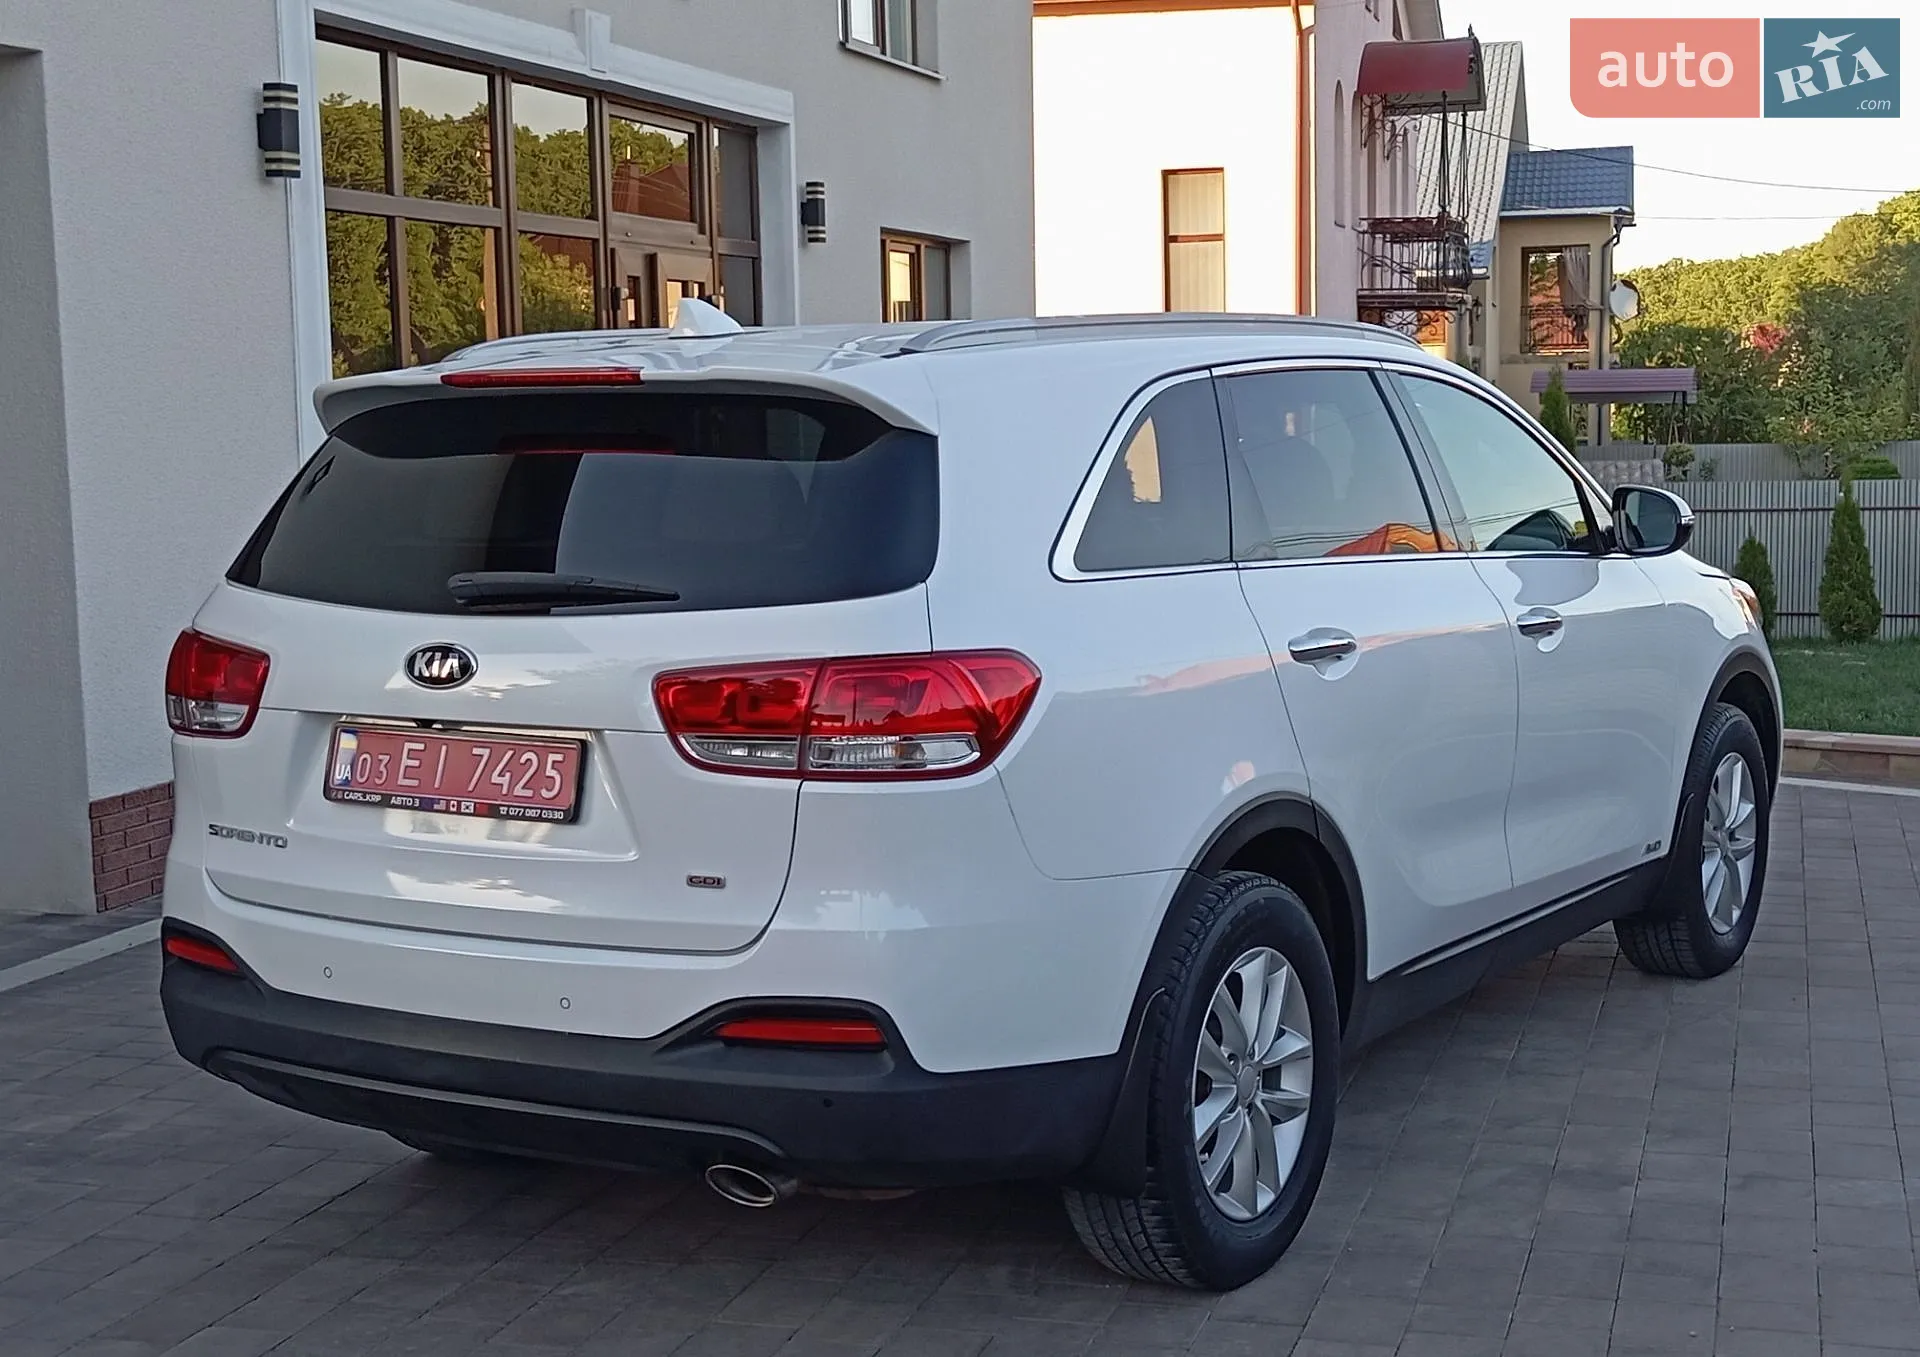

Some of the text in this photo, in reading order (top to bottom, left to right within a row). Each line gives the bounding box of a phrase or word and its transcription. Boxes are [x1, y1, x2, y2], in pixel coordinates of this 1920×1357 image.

[413, 651, 461, 679] KIA
[335, 763, 351, 781] UA
[356, 741, 565, 800] 03 EI 7425
[208, 823, 288, 849] SORENTO
